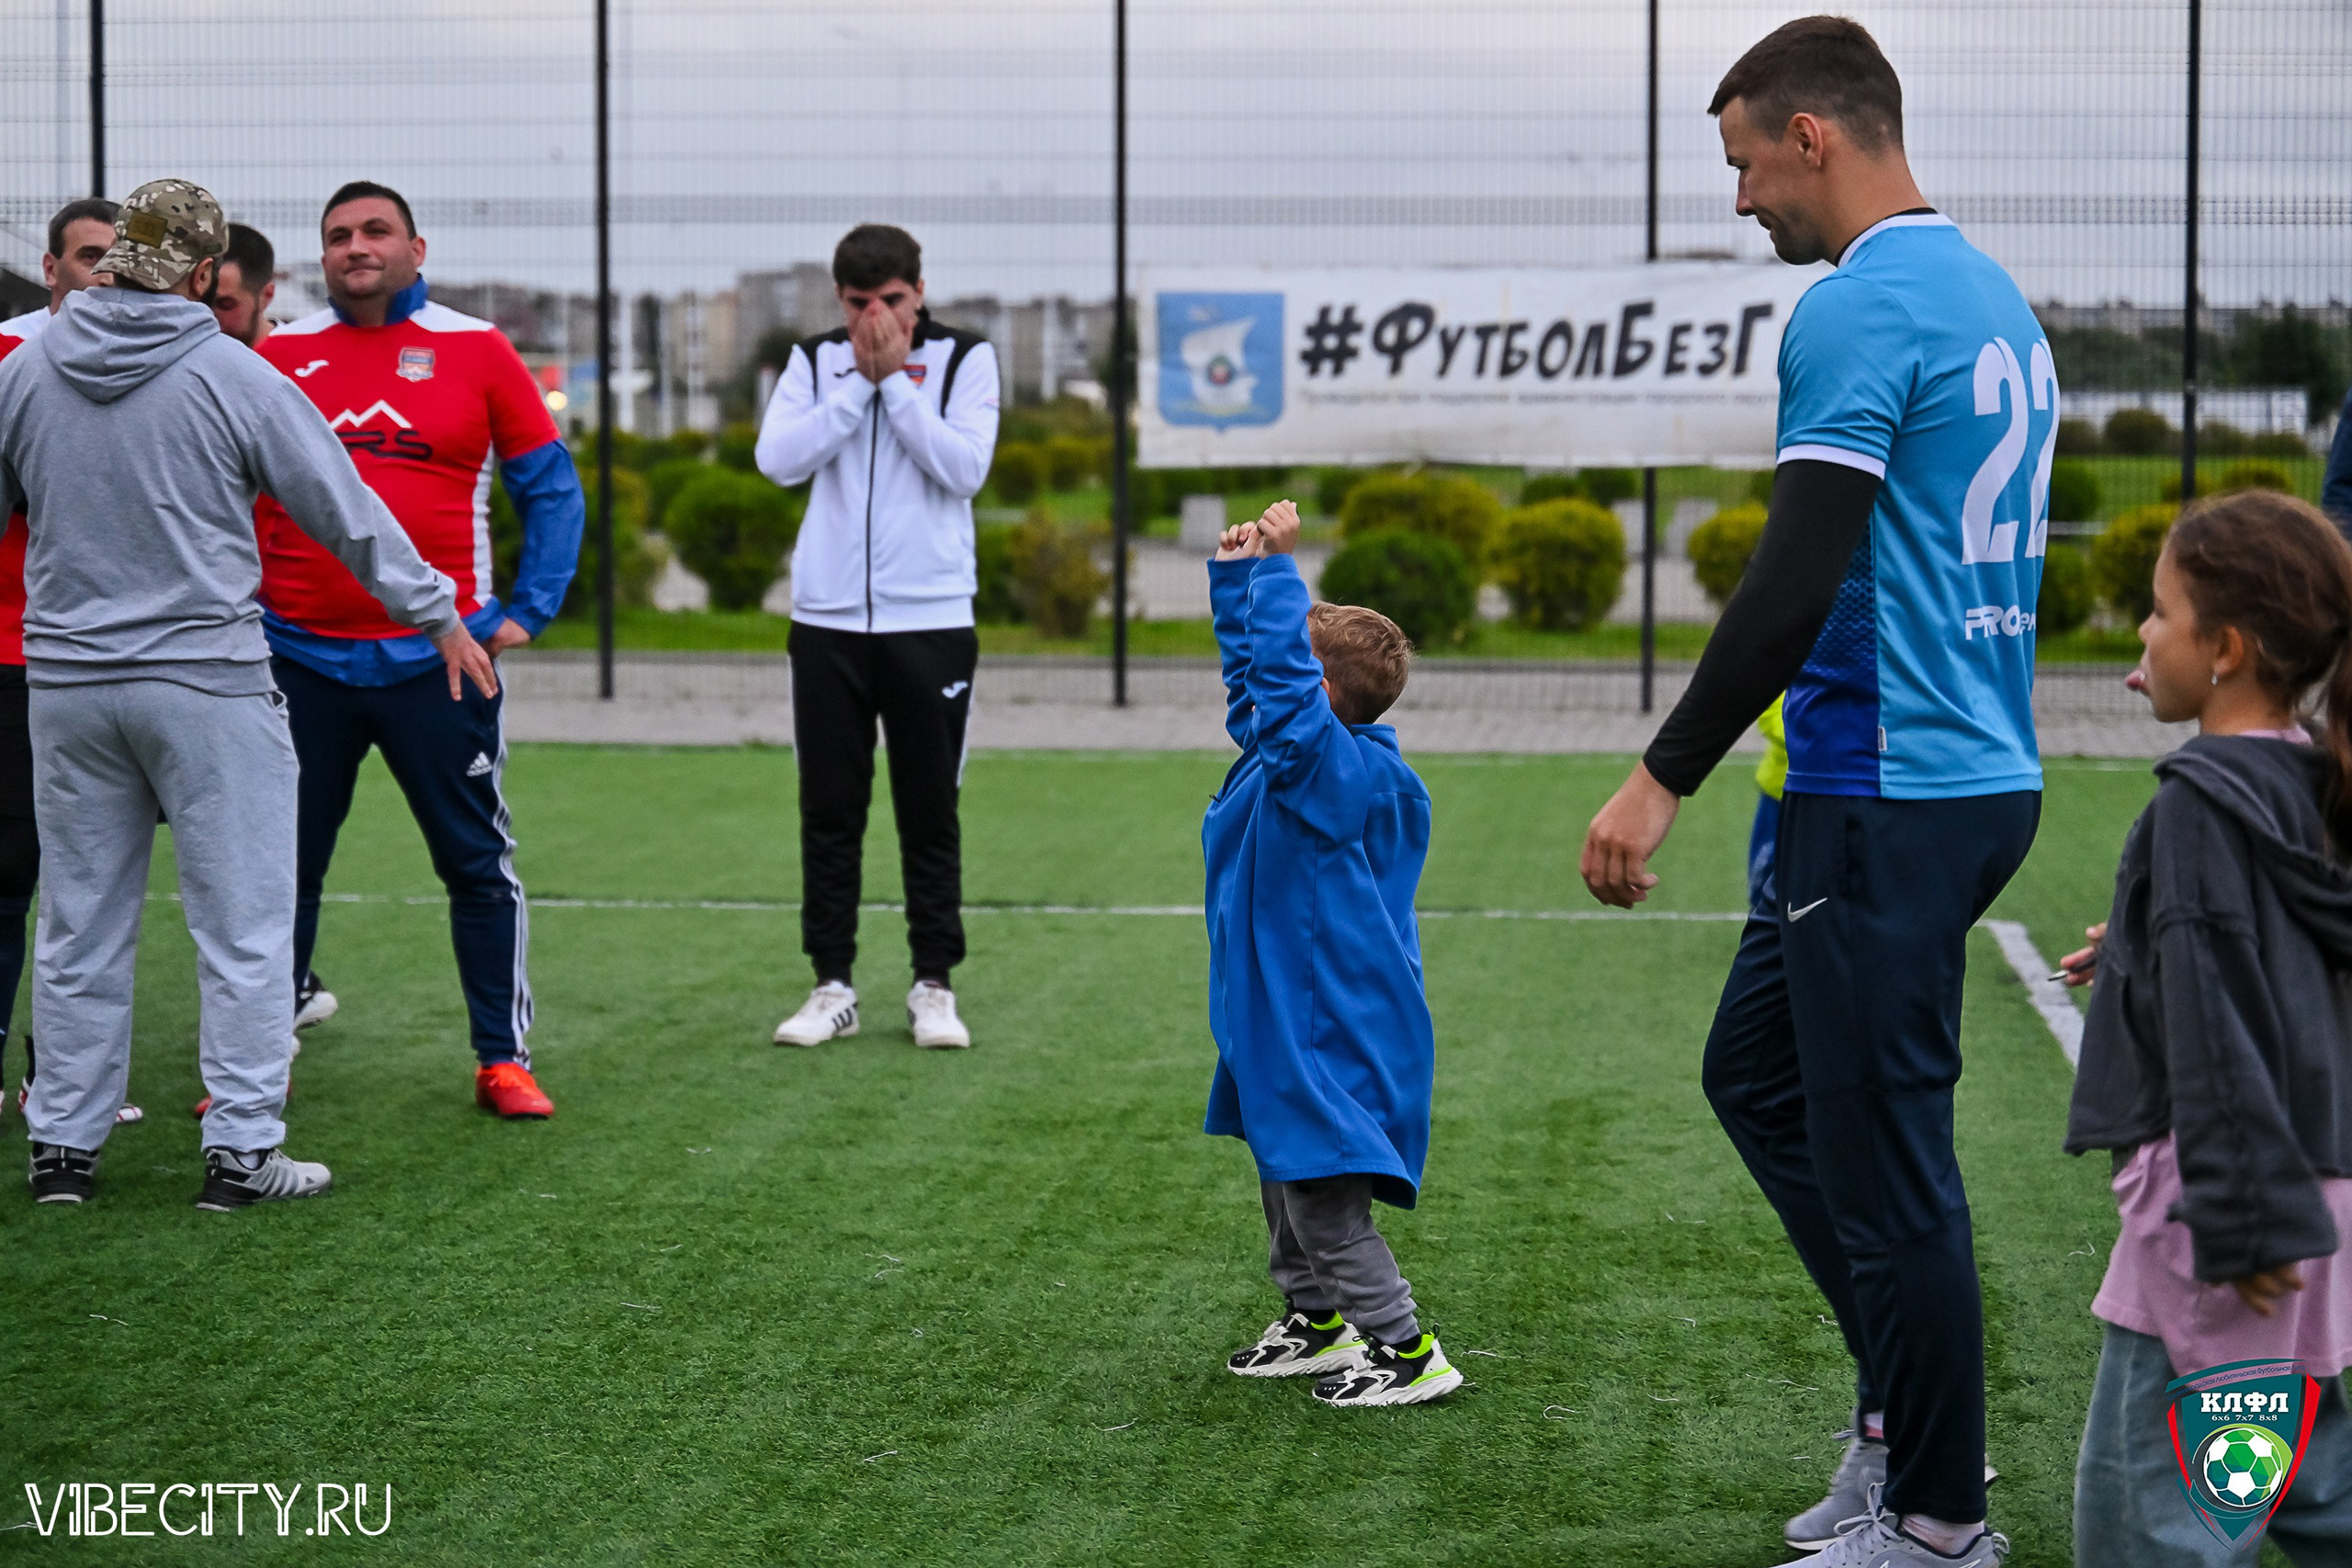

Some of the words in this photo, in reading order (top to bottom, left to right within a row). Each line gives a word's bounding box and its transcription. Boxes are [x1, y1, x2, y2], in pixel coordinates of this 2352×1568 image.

[1299, 300, 1773, 379] #ФутболБезГ
[333, 429, 433, 461] RS
[1962, 336, 2061, 565] 22
